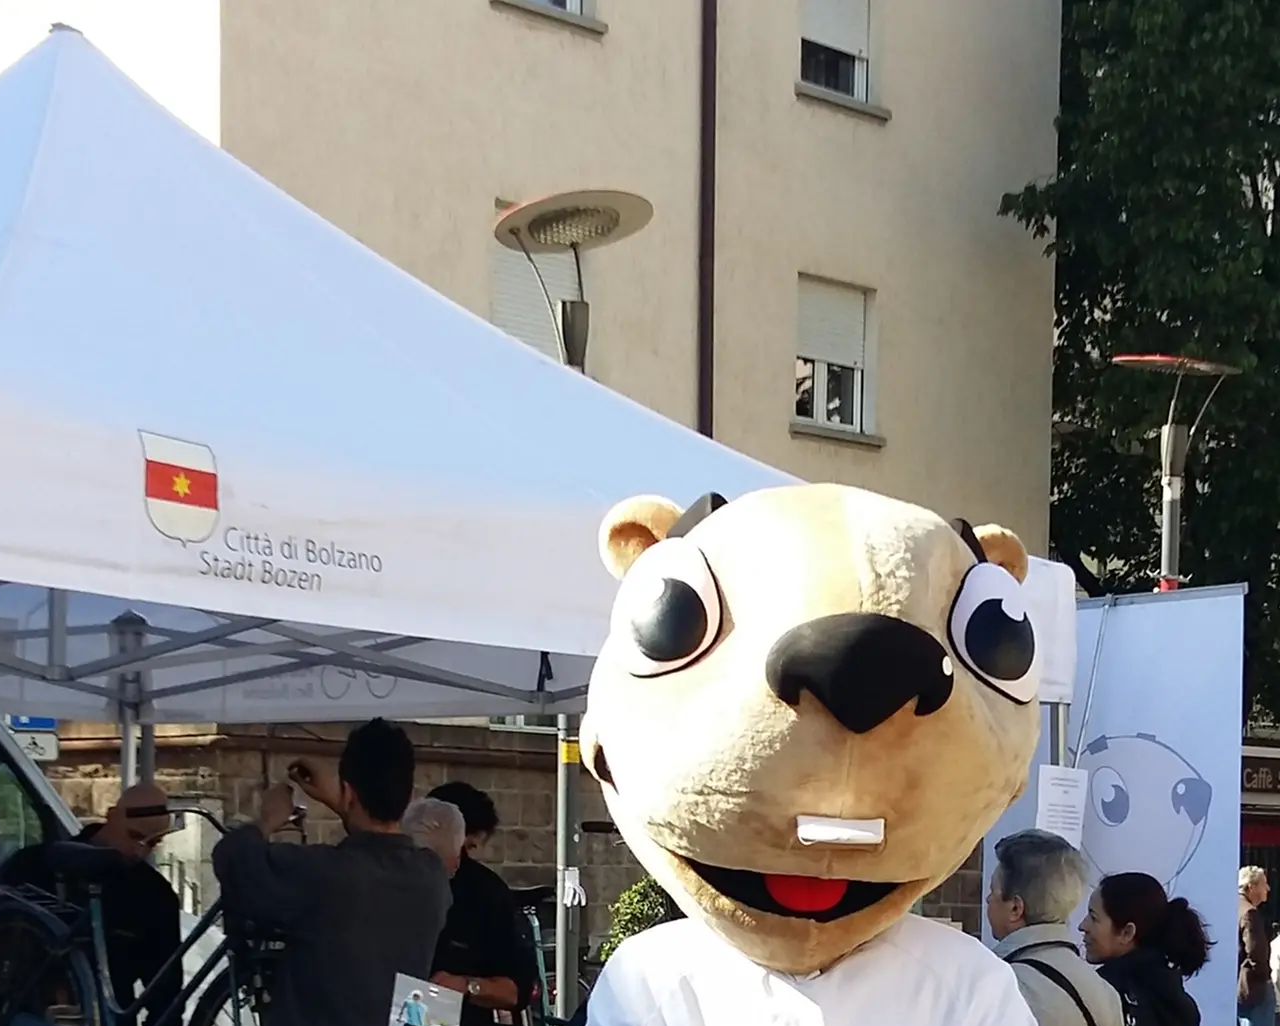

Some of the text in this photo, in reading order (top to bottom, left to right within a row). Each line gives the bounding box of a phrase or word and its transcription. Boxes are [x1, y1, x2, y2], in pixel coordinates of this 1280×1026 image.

[199, 551, 322, 592] Stadt Bozen
[223, 526, 383, 573] Città di Bolzano
